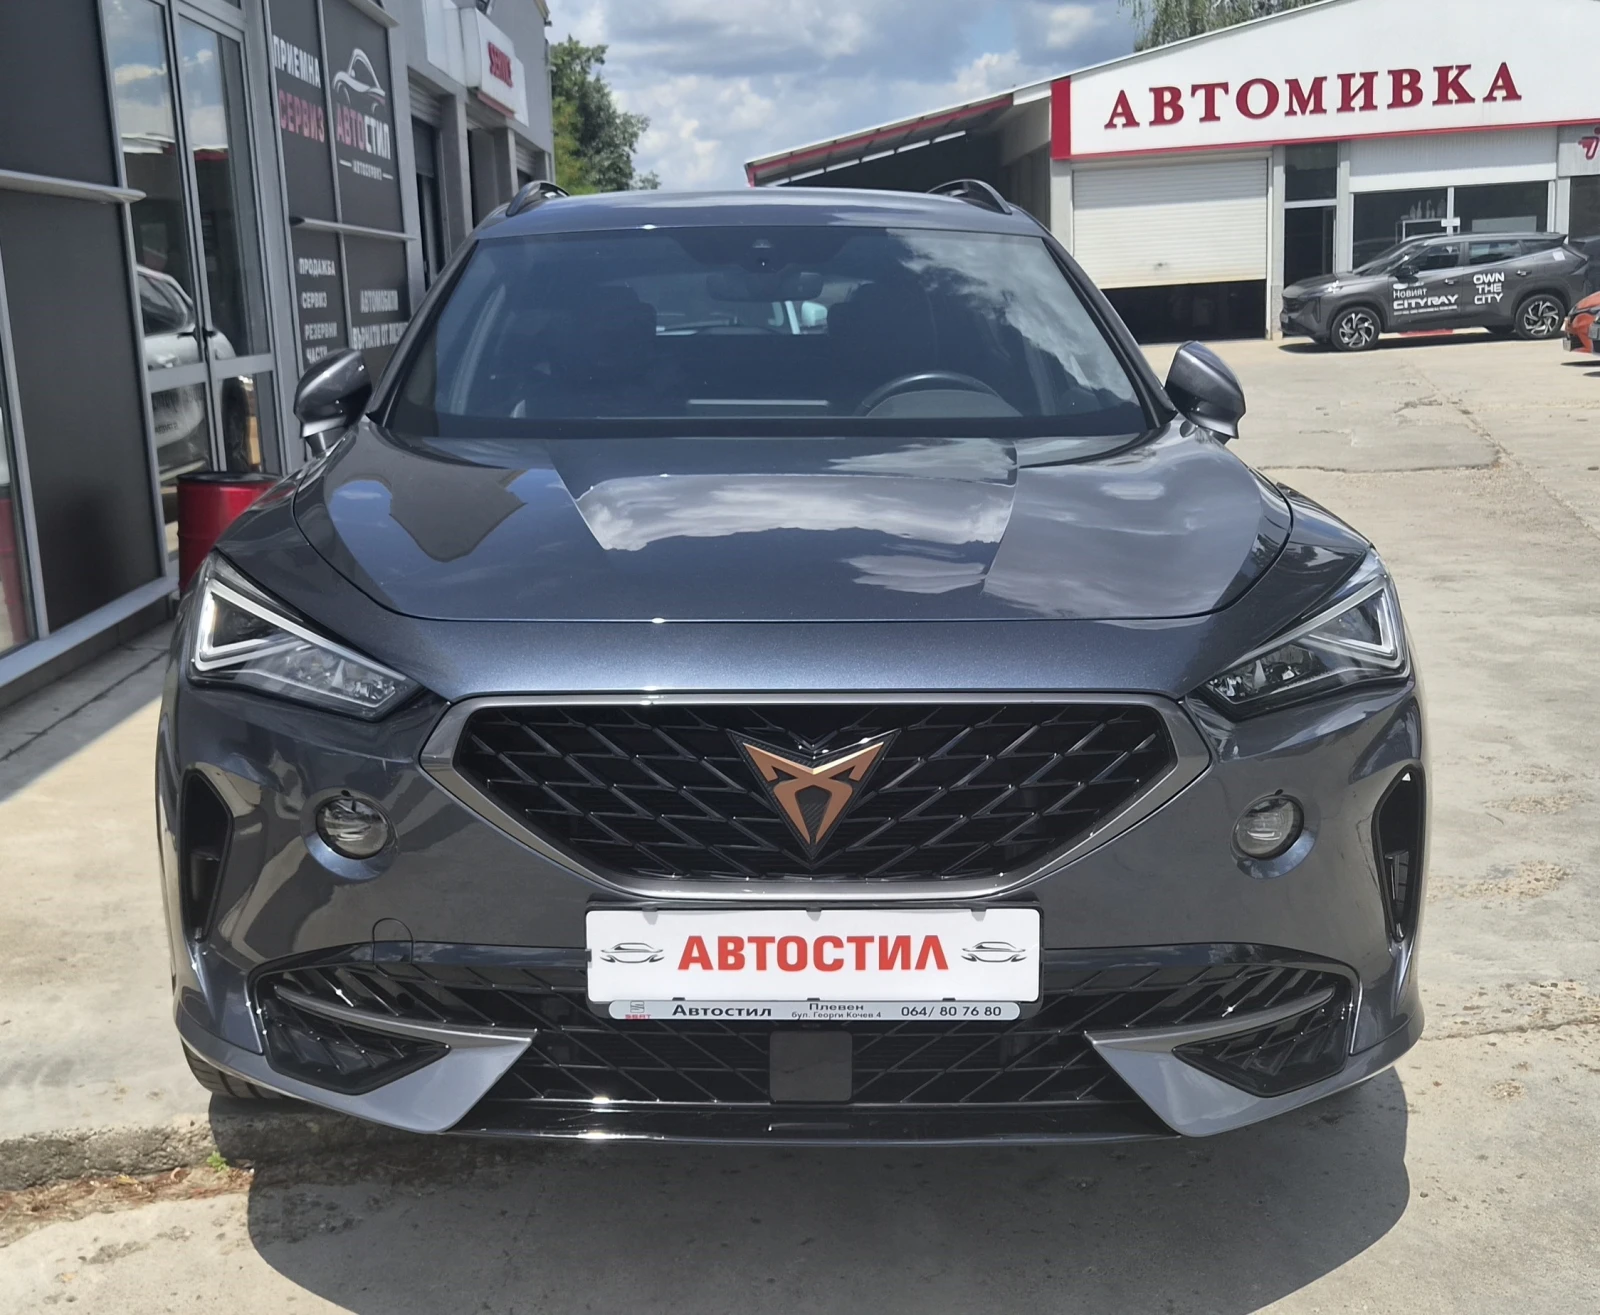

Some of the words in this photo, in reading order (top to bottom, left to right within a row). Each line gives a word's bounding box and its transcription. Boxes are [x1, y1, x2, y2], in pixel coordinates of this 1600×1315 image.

[273, 35, 321, 88] ПРИЕМНА
[1104, 62, 1522, 129] АВТОМИВКА
[279, 88, 325, 143] СЕРВИЗ
[336, 103, 391, 160] АВТОСТИЛ
[299, 258, 336, 277] ПРОДАЖБА
[1473, 272, 1505, 285] OWN
[1476, 283, 1502, 294] THE
[302, 292, 328, 308] СЕРВИЗ
[1393, 294, 1459, 310] CITYRAY
[1474, 293, 1503, 305] CITY
[305, 323, 338, 340] РЕЗЕРВНИ
[677, 935, 949, 972] АВТОСТИЛ
[672, 1004, 772, 1017] Автостил
[809, 1003, 864, 1011] Плевен
[901, 1006, 935, 1017] 064/
[939, 1006, 957, 1017] 80
[962, 1006, 979, 1017] 76
[984, 1006, 1002, 1017] 80
[791, 1012, 811, 1020] бул.
[813, 1012, 844, 1020] Георги
